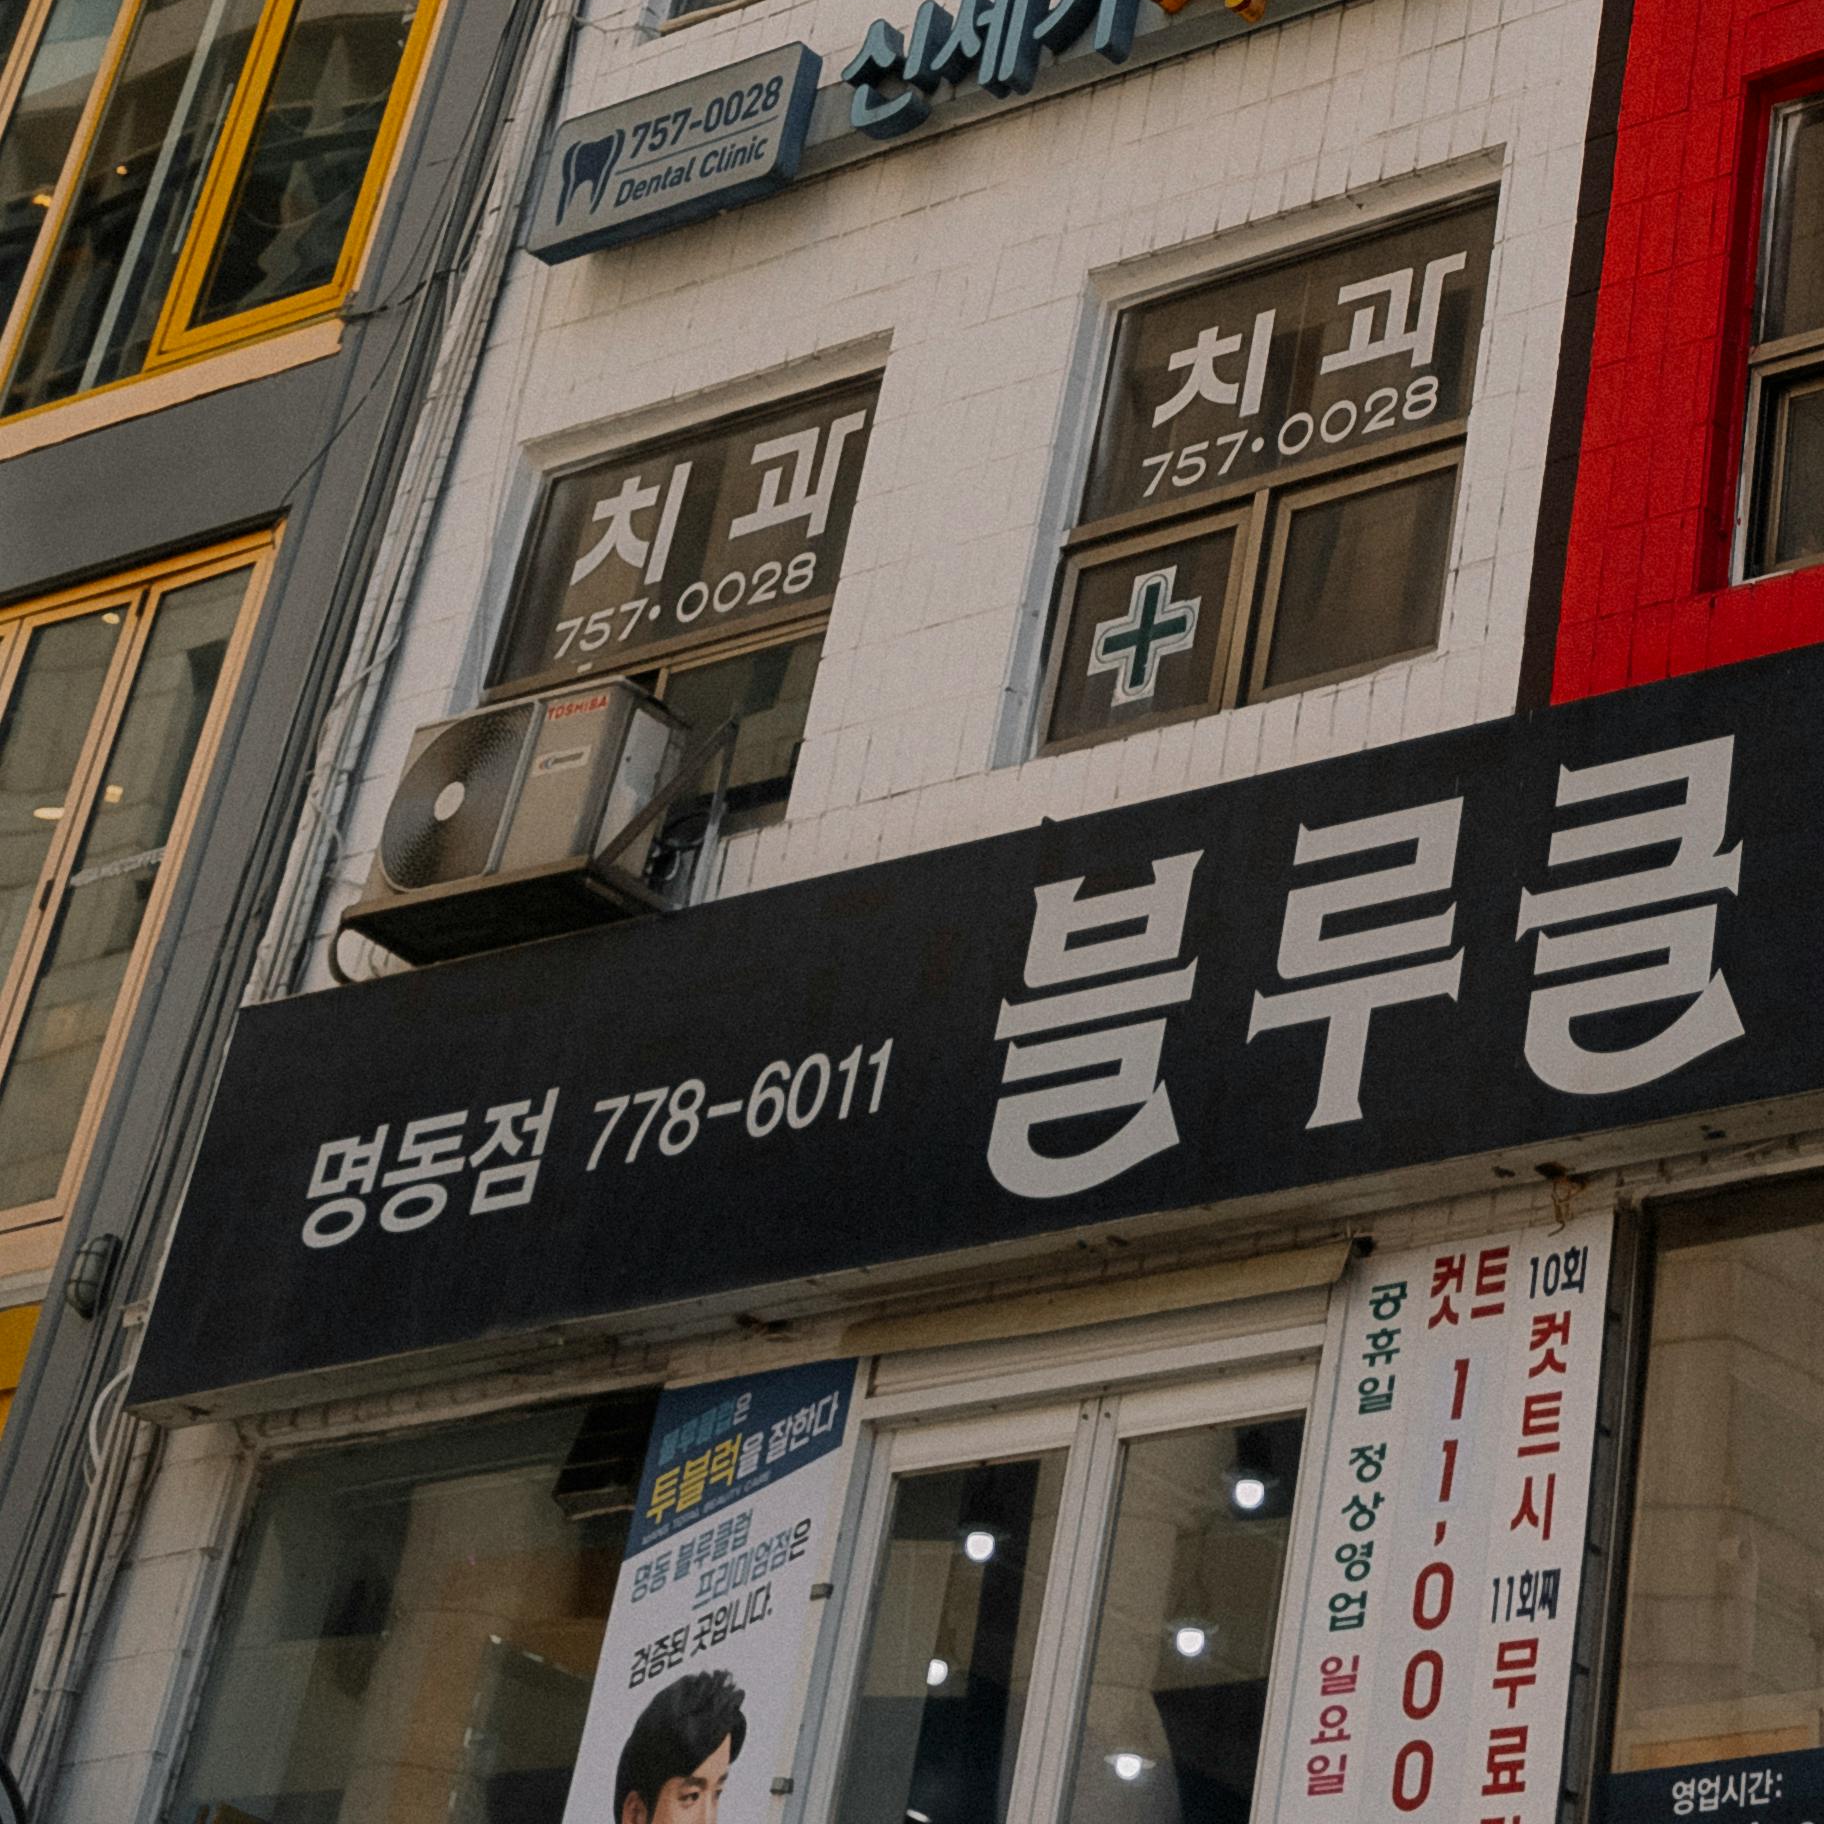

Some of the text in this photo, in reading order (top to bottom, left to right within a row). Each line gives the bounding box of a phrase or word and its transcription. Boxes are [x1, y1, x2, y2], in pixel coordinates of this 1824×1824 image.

[630, 75, 784, 160] 757-0028
[614, 135, 769, 209] Dental Clinic
[547, 695, 608, 721] TOSHIBA
[298, 1088, 559, 1250] 명동점
[586, 1036, 892, 1174] 778-6011
[1427, 1245, 1511, 1331] 컷트
[1527, 1245, 1590, 1300] 10회
[766, 1390, 839, 1465] 잘한다
[1328, 1279, 1409, 1634] 공휴일 정상영업
[631, 1550, 673, 1604] 명동
[1490, 1568, 1562, 1625] 11회째
[628, 1623, 690, 1689] 검증된
[1306, 1653, 1360, 1798] 일요일
[1671, 1768, 1783, 1816] 영업시간:
